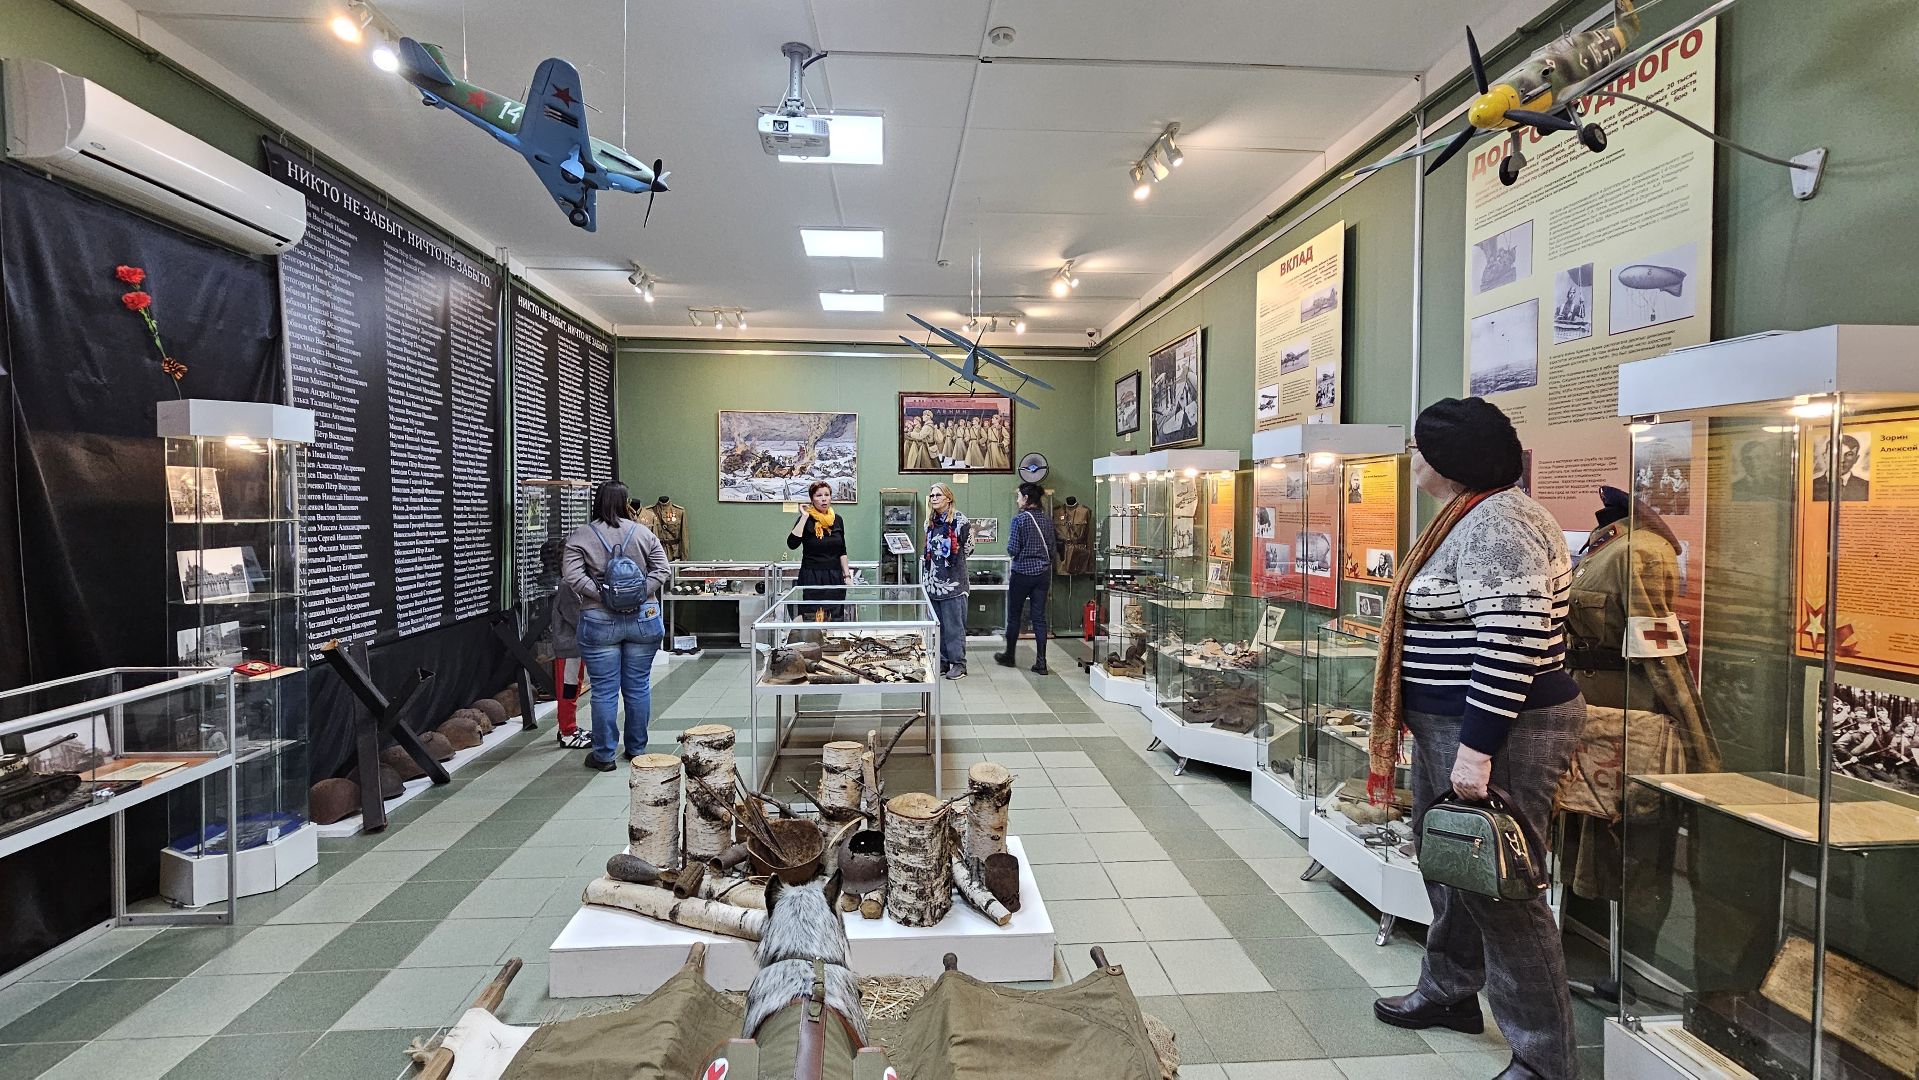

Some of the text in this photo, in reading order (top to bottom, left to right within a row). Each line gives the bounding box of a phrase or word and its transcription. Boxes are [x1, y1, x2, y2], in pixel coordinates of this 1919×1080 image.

[1678, 71, 1697, 84] тысяч
[1671, 80, 1697, 95] средств
[1674, 92, 1688, 102] бою
[498, 102, 524, 124] 14
[288, 160, 492, 288] НИКТО НЕ ЗАБЫТ, НИЧТО НЕ ЗАБЫТО.
[1280, 245, 1313, 277] ВКЛАД
[518, 295, 539, 315] НИКТО
[540, 308, 548, 320] НЕ
[548, 313, 567, 332] ЗАБЫТ,
[567, 324, 584, 340] НИЧТО
[1880, 444, 1917, 452] Алексей
[318, 535, 336, 543] Сергей
